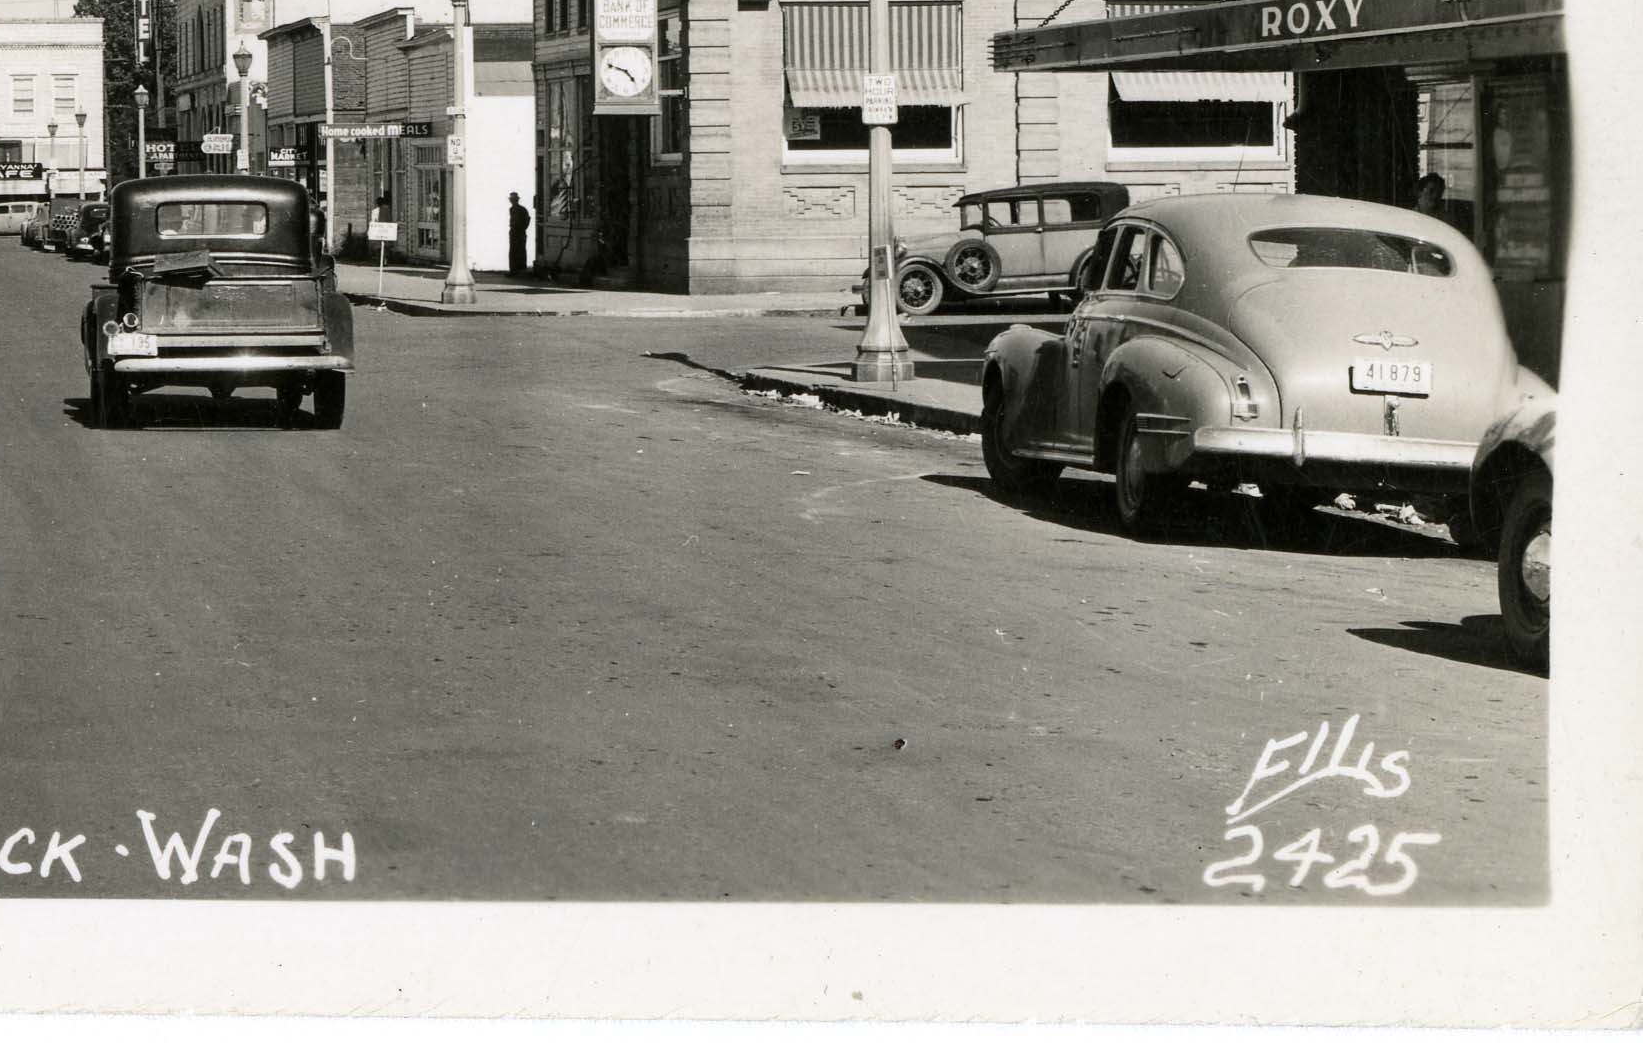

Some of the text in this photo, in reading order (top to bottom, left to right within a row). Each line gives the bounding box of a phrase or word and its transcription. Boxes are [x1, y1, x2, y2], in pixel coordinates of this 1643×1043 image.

[603, 0, 649, 12] BANK OF
[599, 15, 653, 29] COMMERCE
[321, 126, 348, 136] Home
[351, 125, 385, 136] cooked
[1366, 363, 1421, 382] 41879
